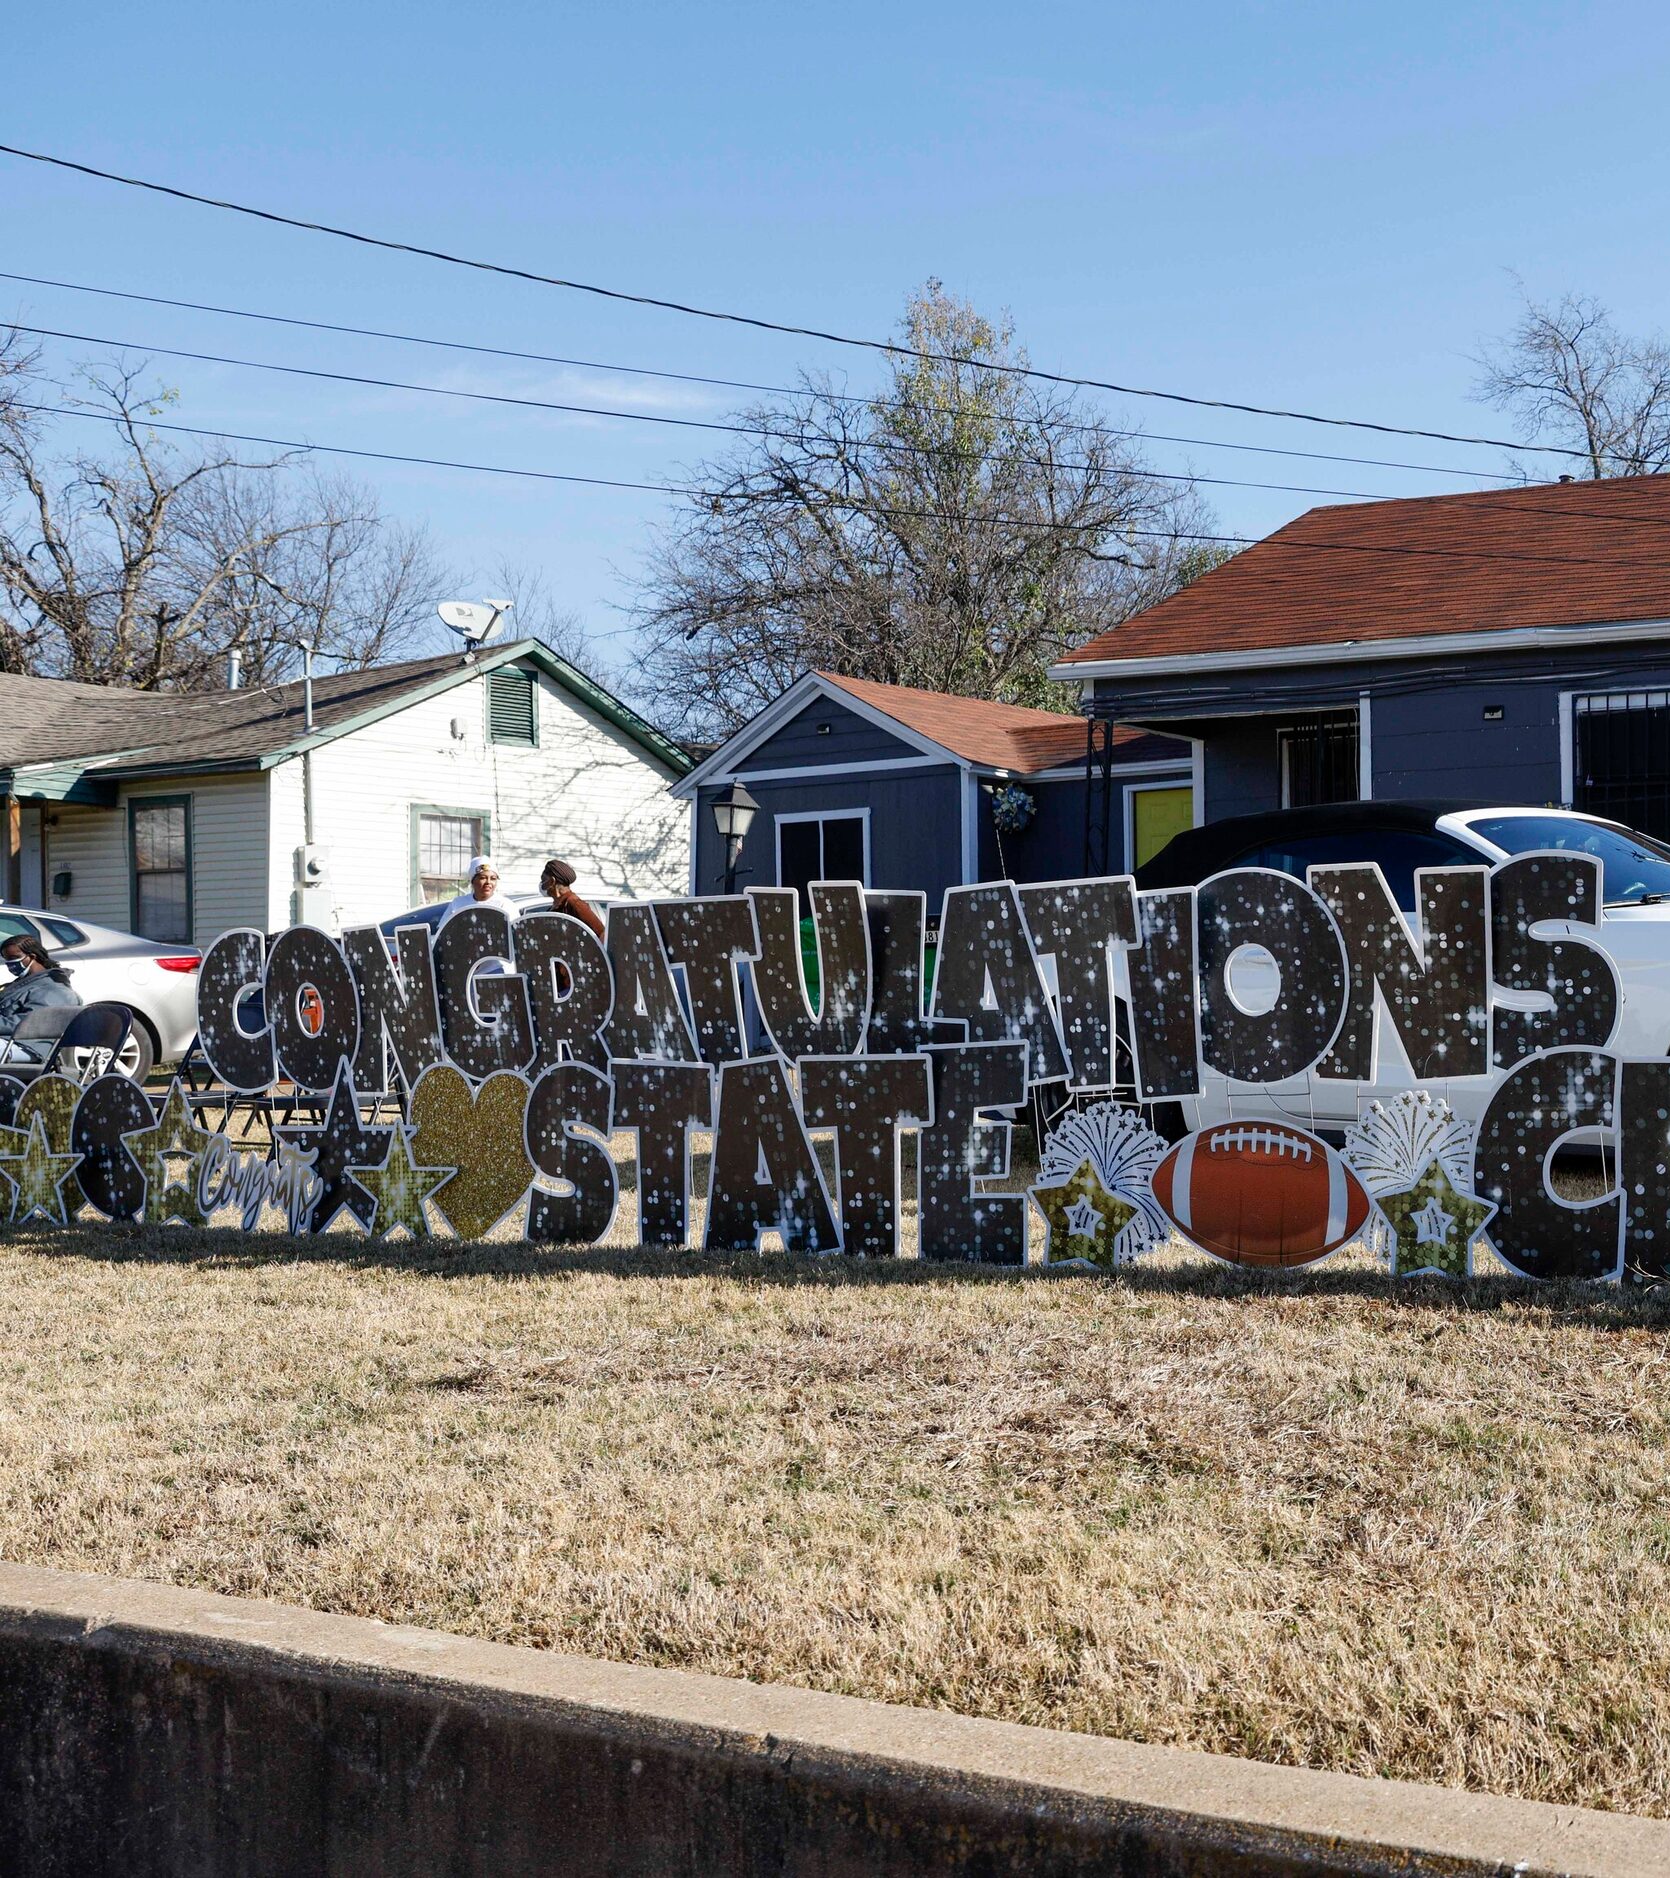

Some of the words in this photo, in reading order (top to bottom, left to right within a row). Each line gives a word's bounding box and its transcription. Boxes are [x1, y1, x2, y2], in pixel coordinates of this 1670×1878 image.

[197, 850, 1624, 1101] CONGRATULATIONS
[199, 1138, 322, 1237] Congrats
[523, 1039, 1029, 1267] STATE
